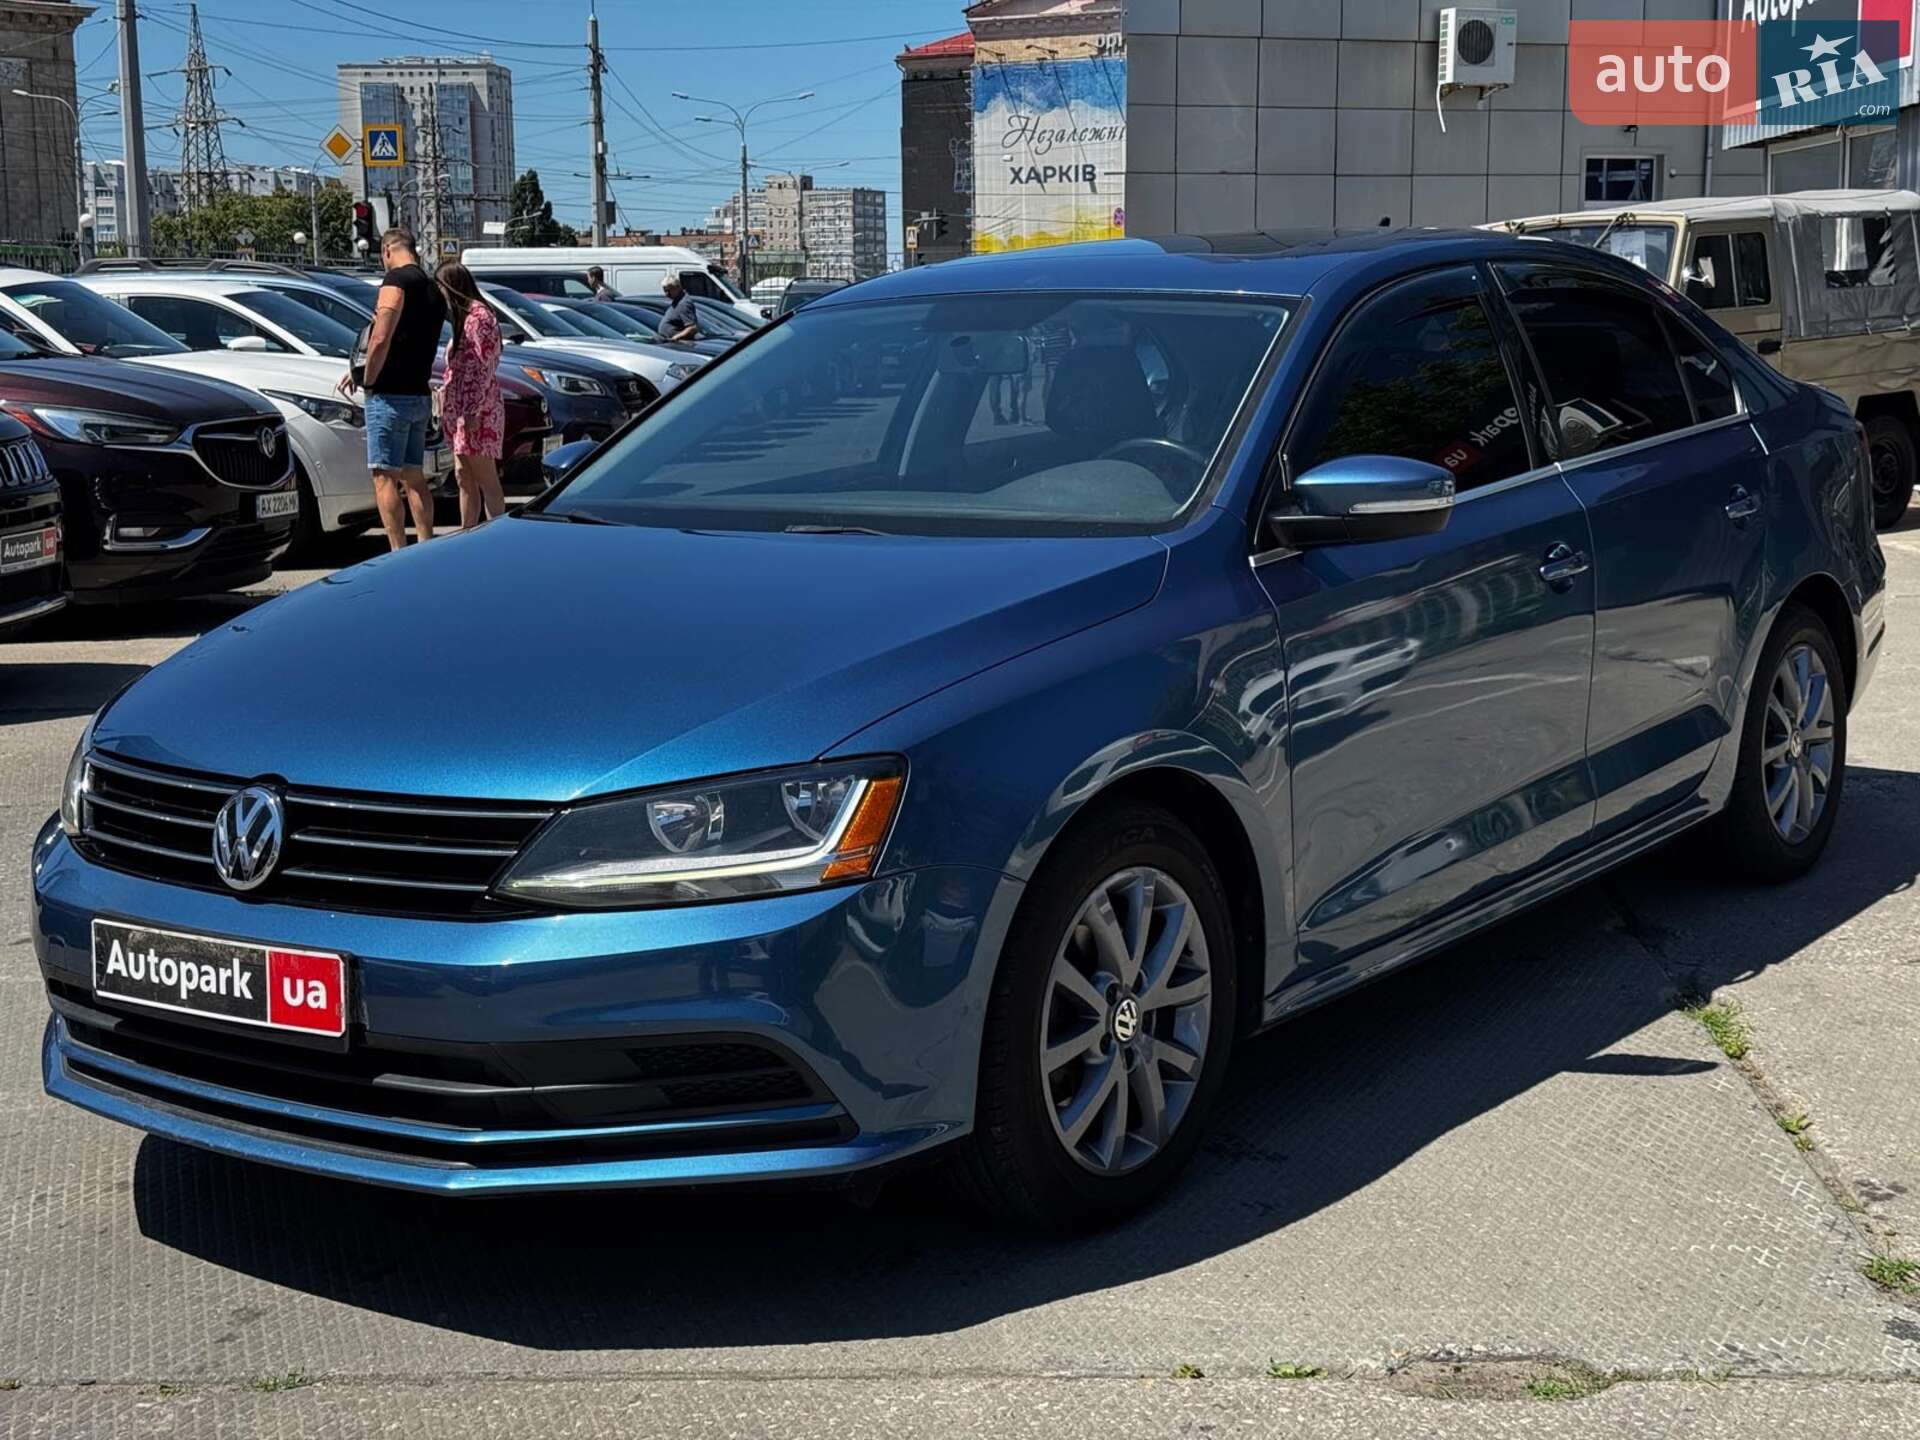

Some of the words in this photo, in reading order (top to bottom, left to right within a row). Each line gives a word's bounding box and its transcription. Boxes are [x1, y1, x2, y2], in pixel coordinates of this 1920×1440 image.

[1009, 164, 1097, 185] ХАРКІВ
[3, 535, 42, 558] Autopark
[106, 938, 253, 1000] Autopark
[282, 976, 327, 1009] ua
